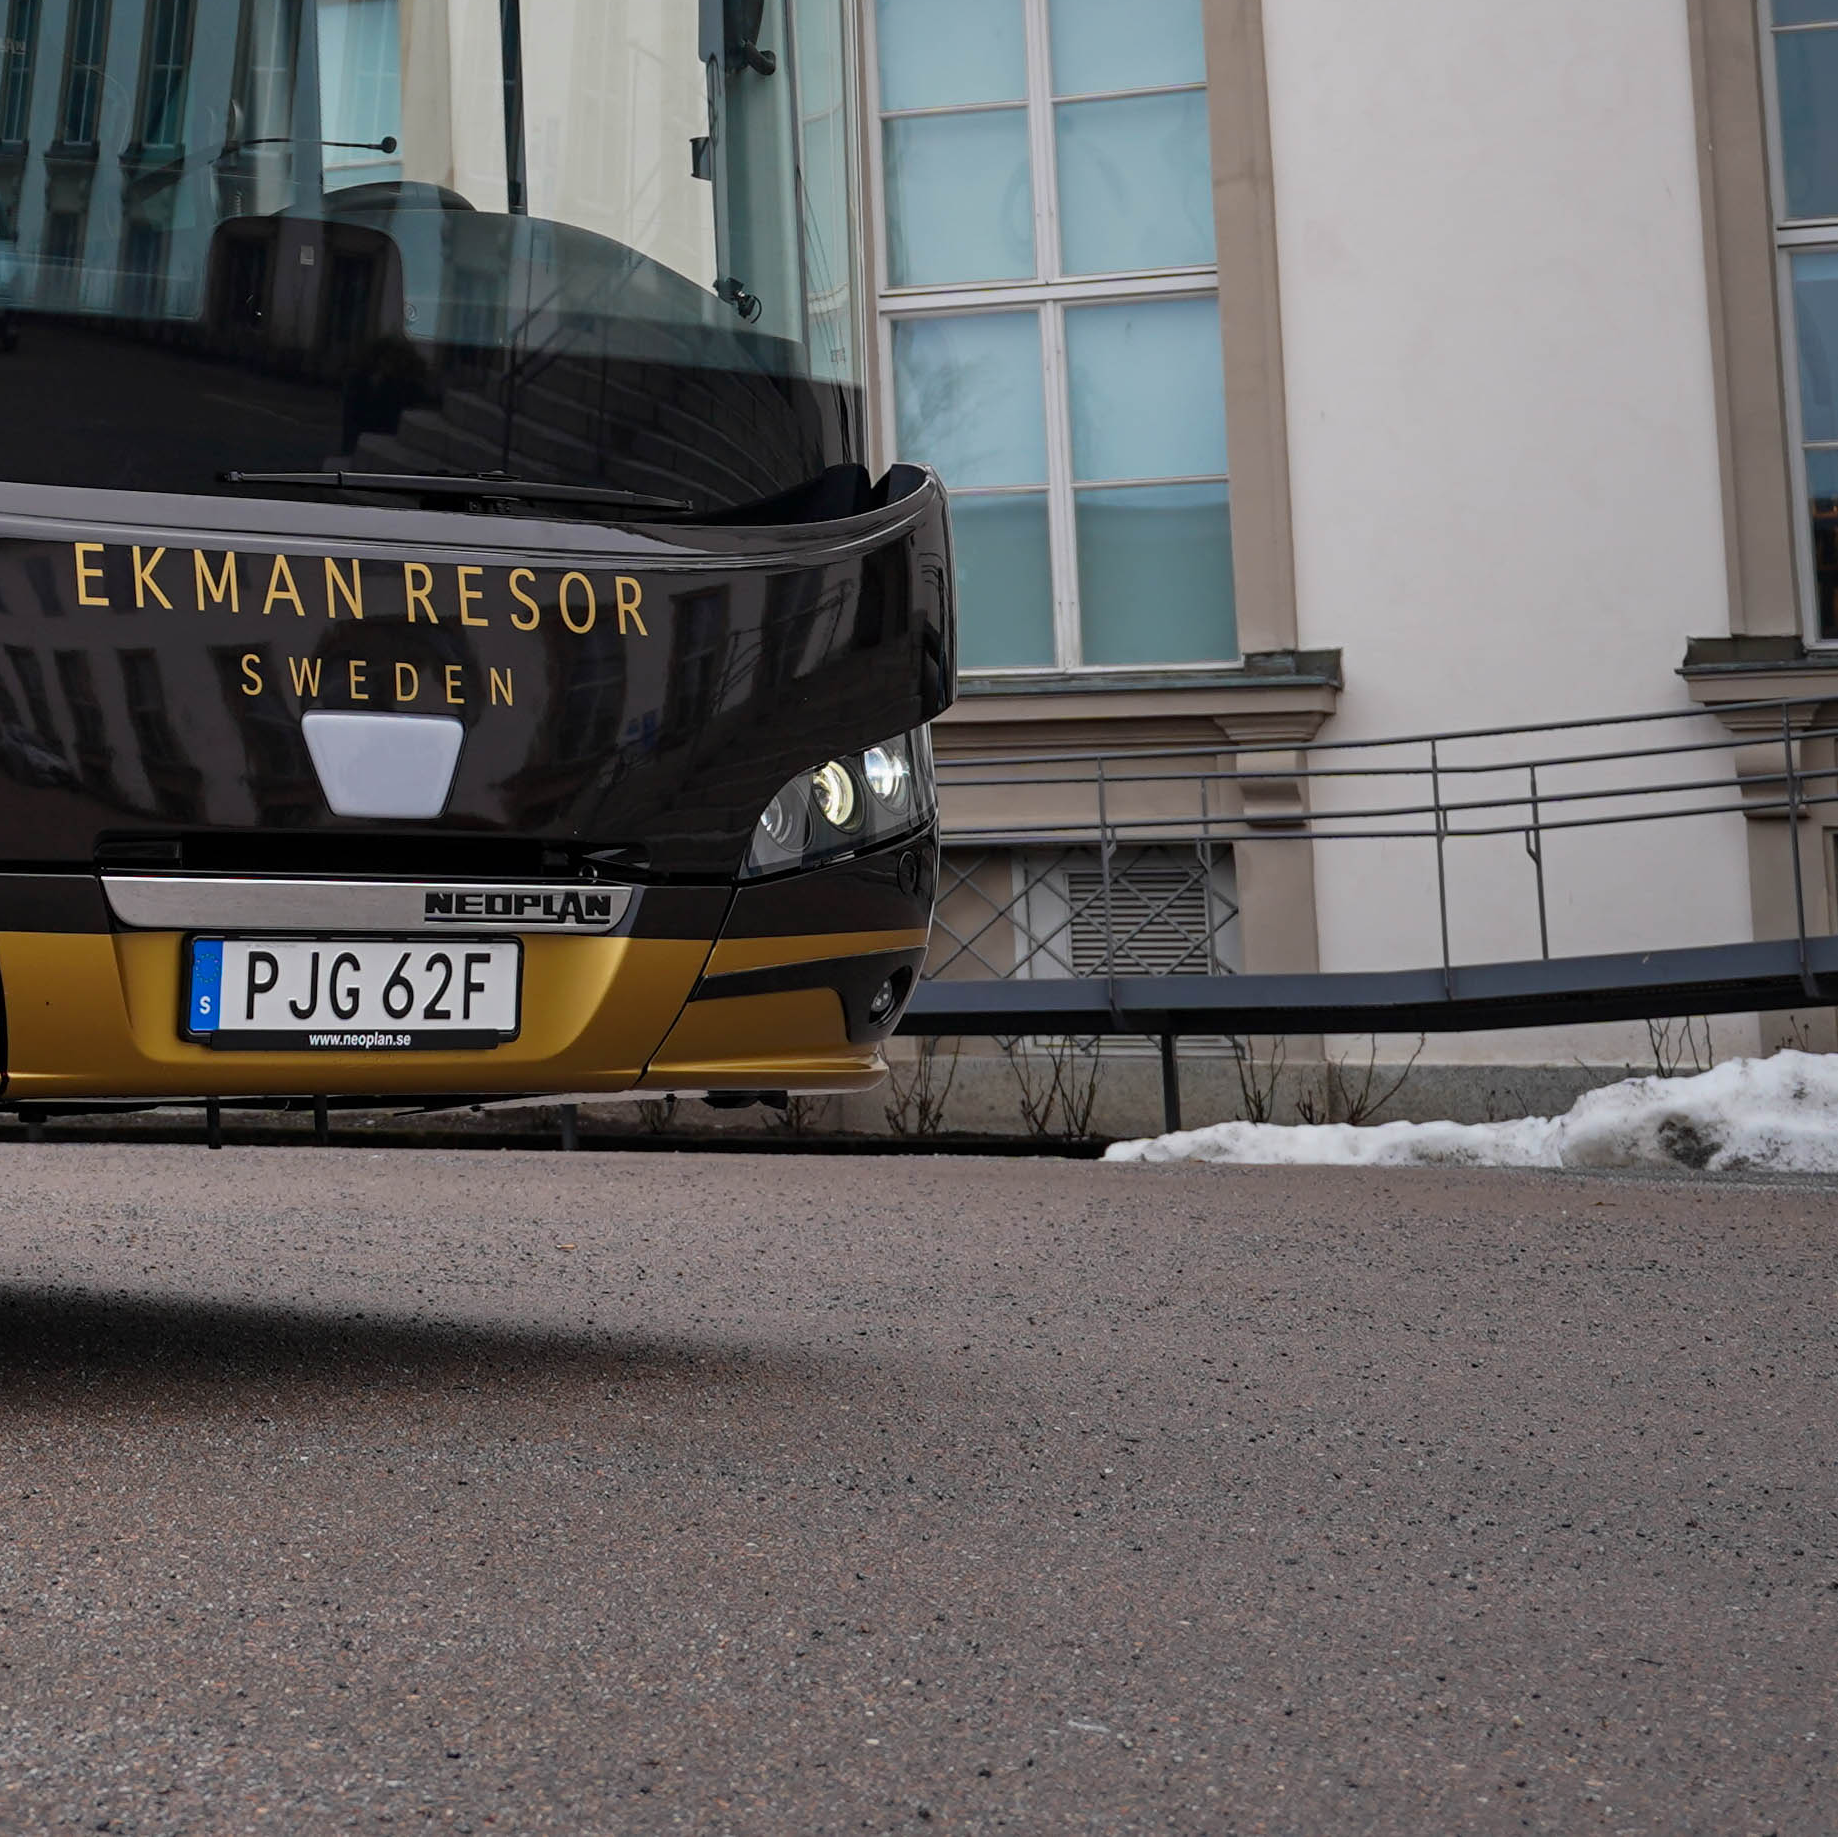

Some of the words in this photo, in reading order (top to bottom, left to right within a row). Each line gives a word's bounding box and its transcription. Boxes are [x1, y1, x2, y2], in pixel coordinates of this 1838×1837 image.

[73, 541, 365, 620] EKMAN
[404, 562, 649, 637] RESOR
[240, 653, 514, 707] SWEDEN
[425, 892, 612, 925] NEOPLAN
[198, 995, 212, 1015] S
[244, 951, 361, 1021] PJG
[381, 951, 493, 1021] 62F
[308, 1030, 412, 1049] www.neoplan.se
